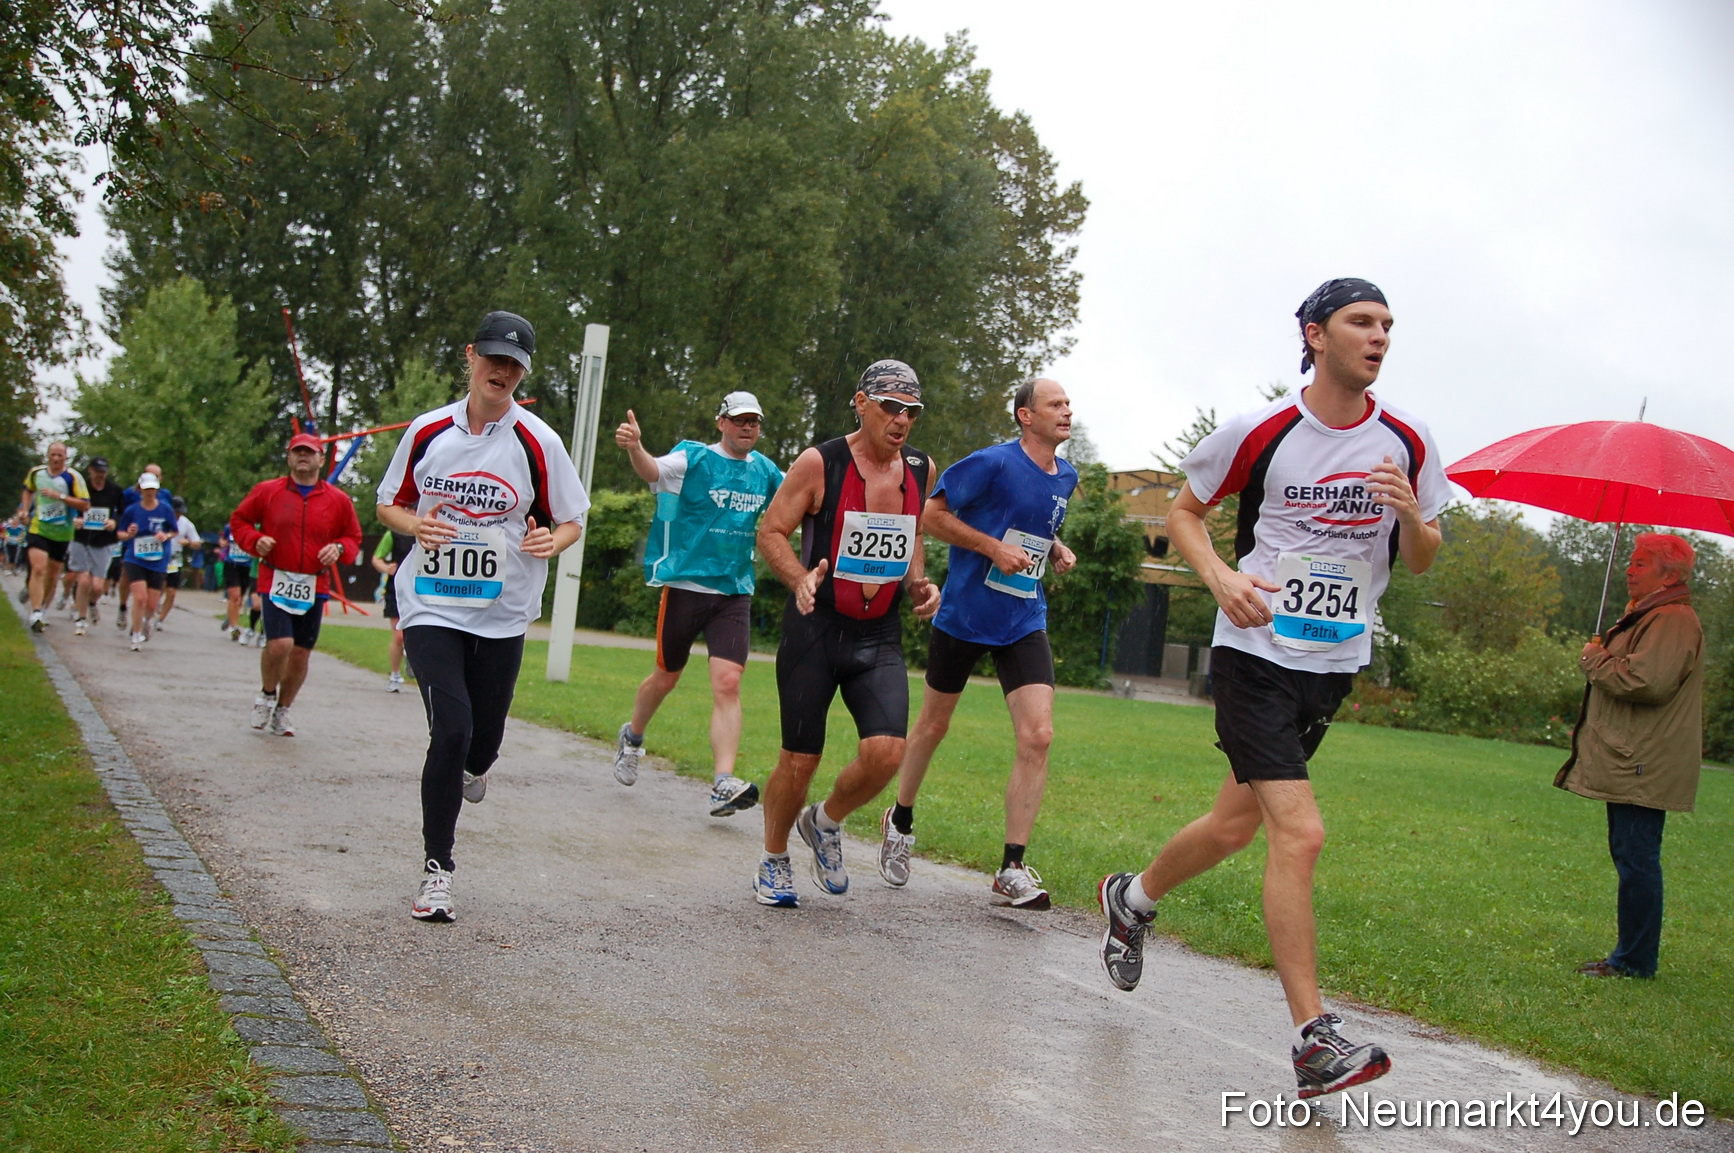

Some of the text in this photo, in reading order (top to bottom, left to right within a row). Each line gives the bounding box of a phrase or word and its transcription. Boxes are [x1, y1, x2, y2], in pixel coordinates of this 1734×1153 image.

[422, 489, 456, 500] Autohaus
[424, 476, 500, 497] GERHART
[456, 494, 508, 511] JÄNIG
[730, 491, 766, 505] RUNNE
[1284, 500, 1328, 509] Autohaus
[1326, 499, 1384, 515] JÄNIG
[867, 518, 895, 526] BOCK
[848, 531, 908, 560] 3253
[424, 548, 497, 578] 3106
[863, 563, 886, 574] Gerd
[1310, 562, 1346, 574] BOCK
[275, 582, 310, 600] 2453
[434, 582, 482, 596] Cornelia
[1283, 578, 1359, 620] 3254
[1302, 623, 1339, 640] Patrik
